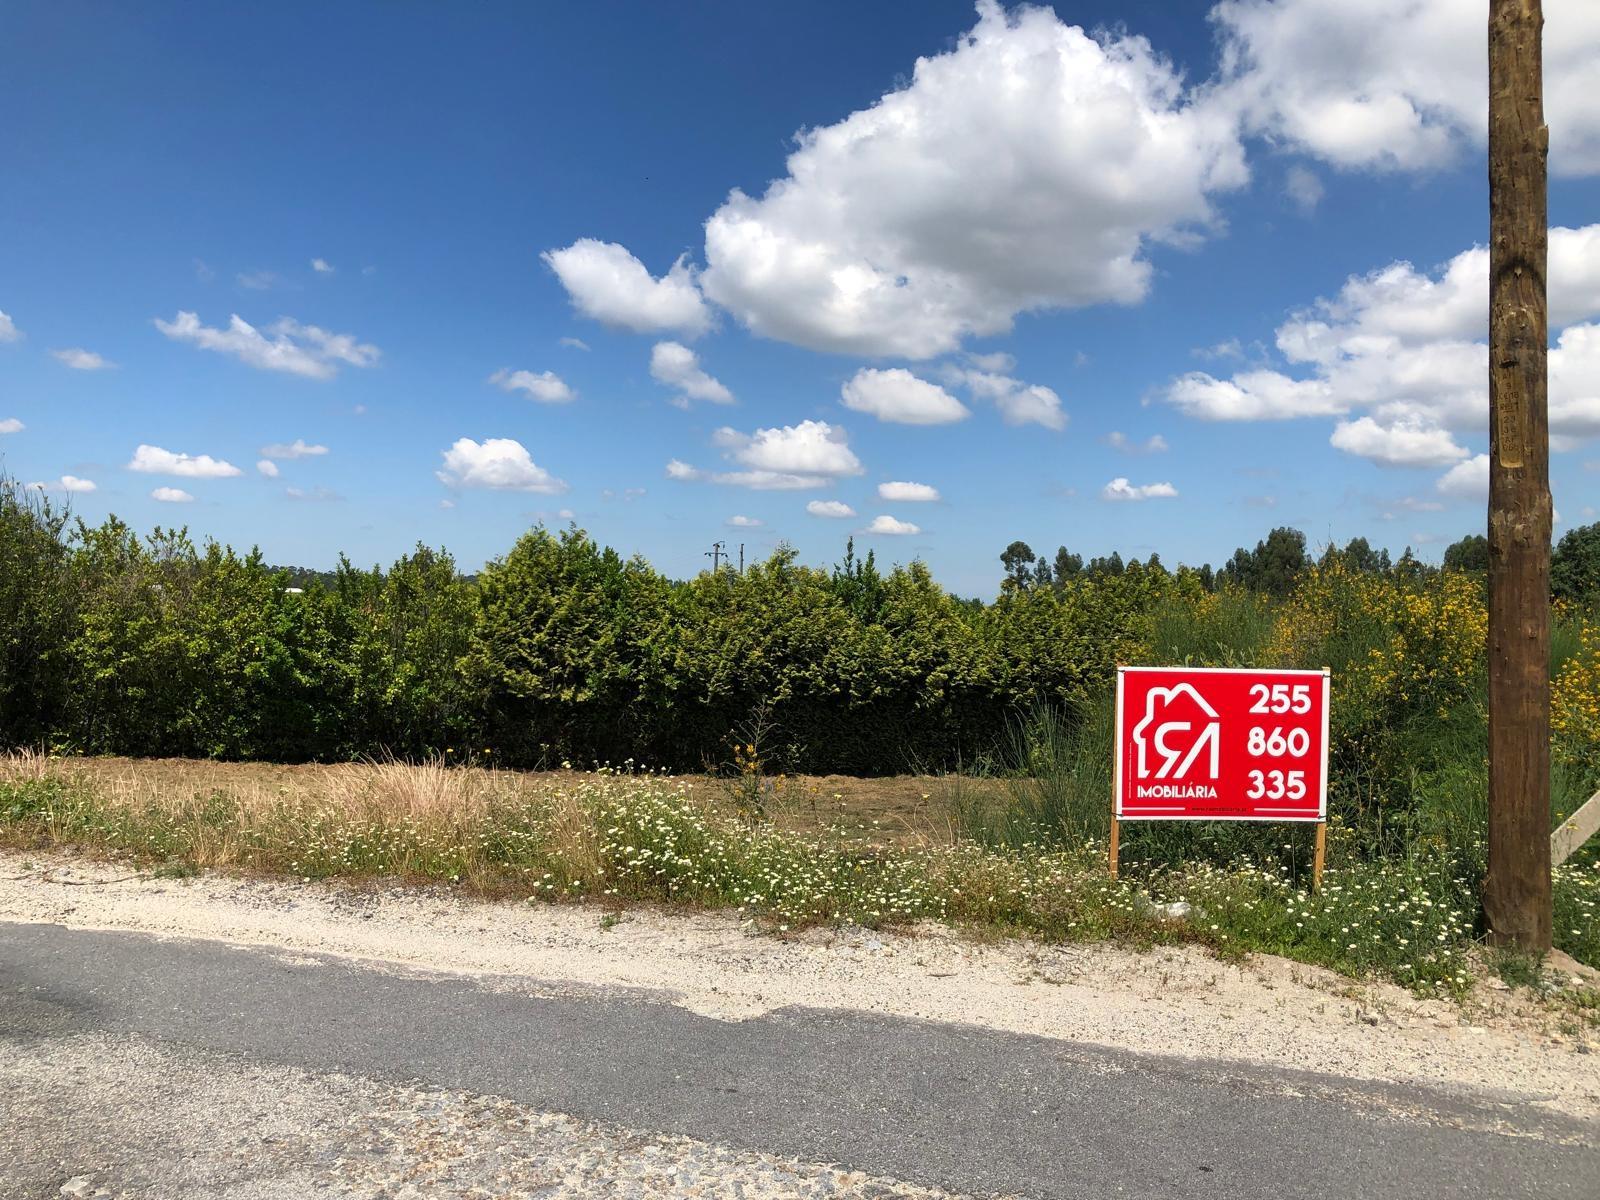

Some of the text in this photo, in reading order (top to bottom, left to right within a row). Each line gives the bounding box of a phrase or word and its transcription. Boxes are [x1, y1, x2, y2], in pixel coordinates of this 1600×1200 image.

[1248, 683, 1312, 715] 255
[1247, 726, 1310, 757] 860
[1137, 781, 1218, 799] IMOBILIÁRIA
[1246, 769, 1306, 800] 335
